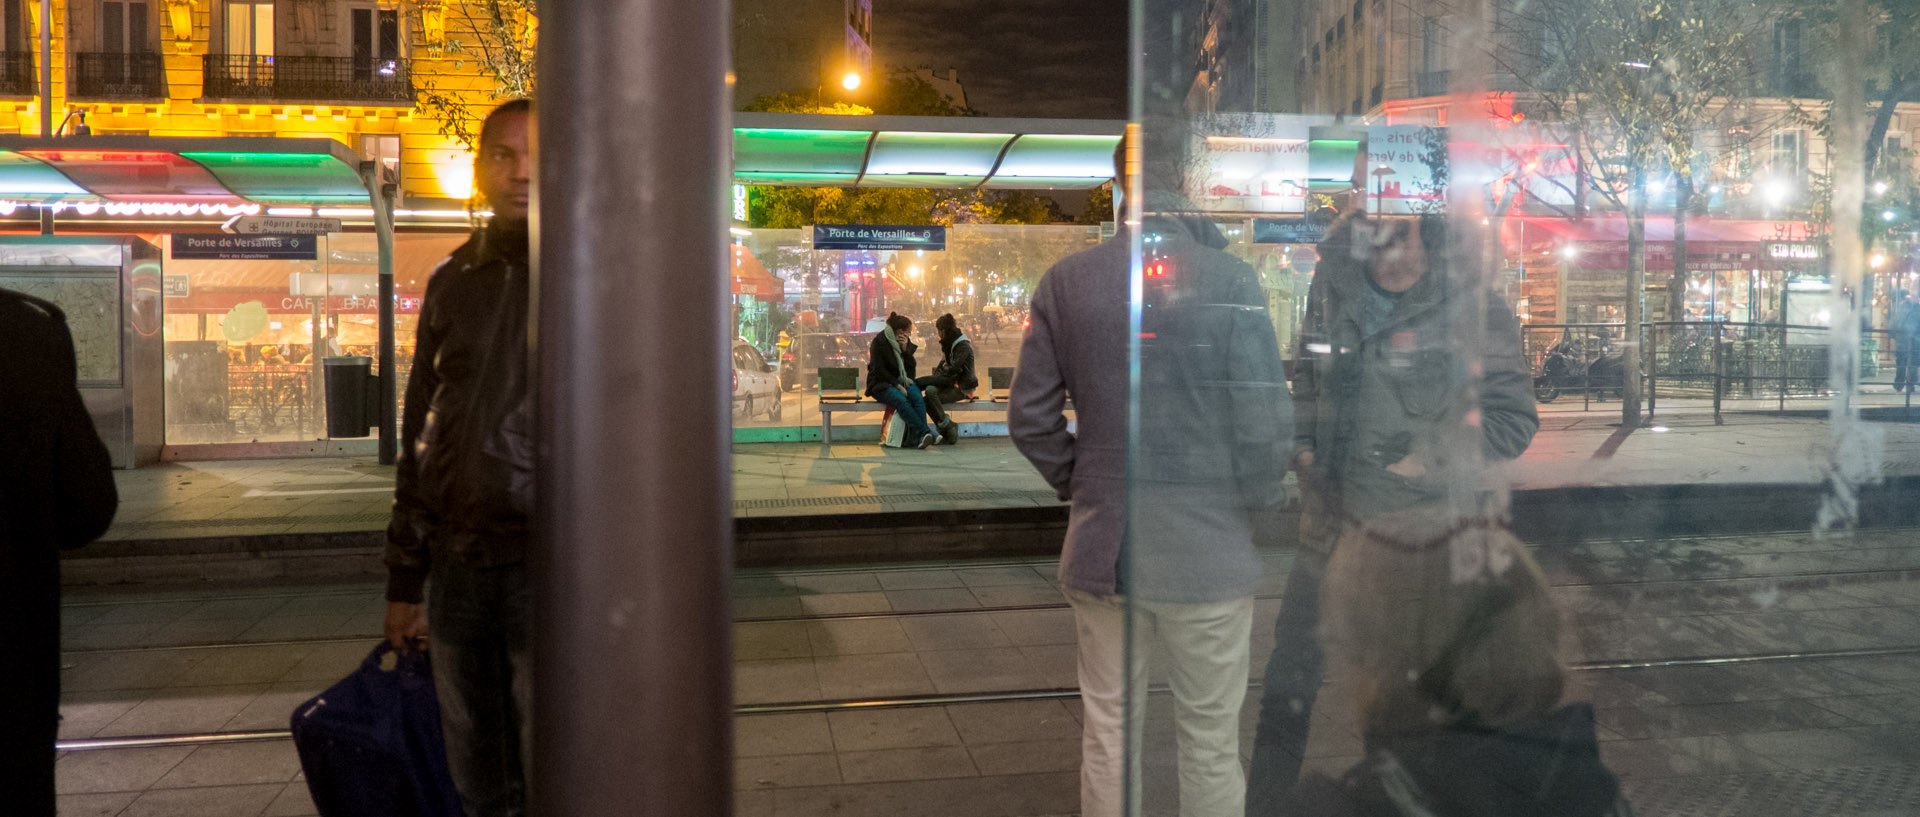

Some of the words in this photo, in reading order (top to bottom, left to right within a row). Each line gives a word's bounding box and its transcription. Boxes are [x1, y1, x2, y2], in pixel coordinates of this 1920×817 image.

[1269, 223, 1293, 232] Porte
[1295, 223, 1307, 232] de
[829, 229, 855, 238] Porte
[857, 229, 870, 238] de
[871, 229, 916, 239] Versailles
[187, 238, 216, 248] Porte
[218, 238, 232, 248] de
[233, 238, 282, 248] Versailles
